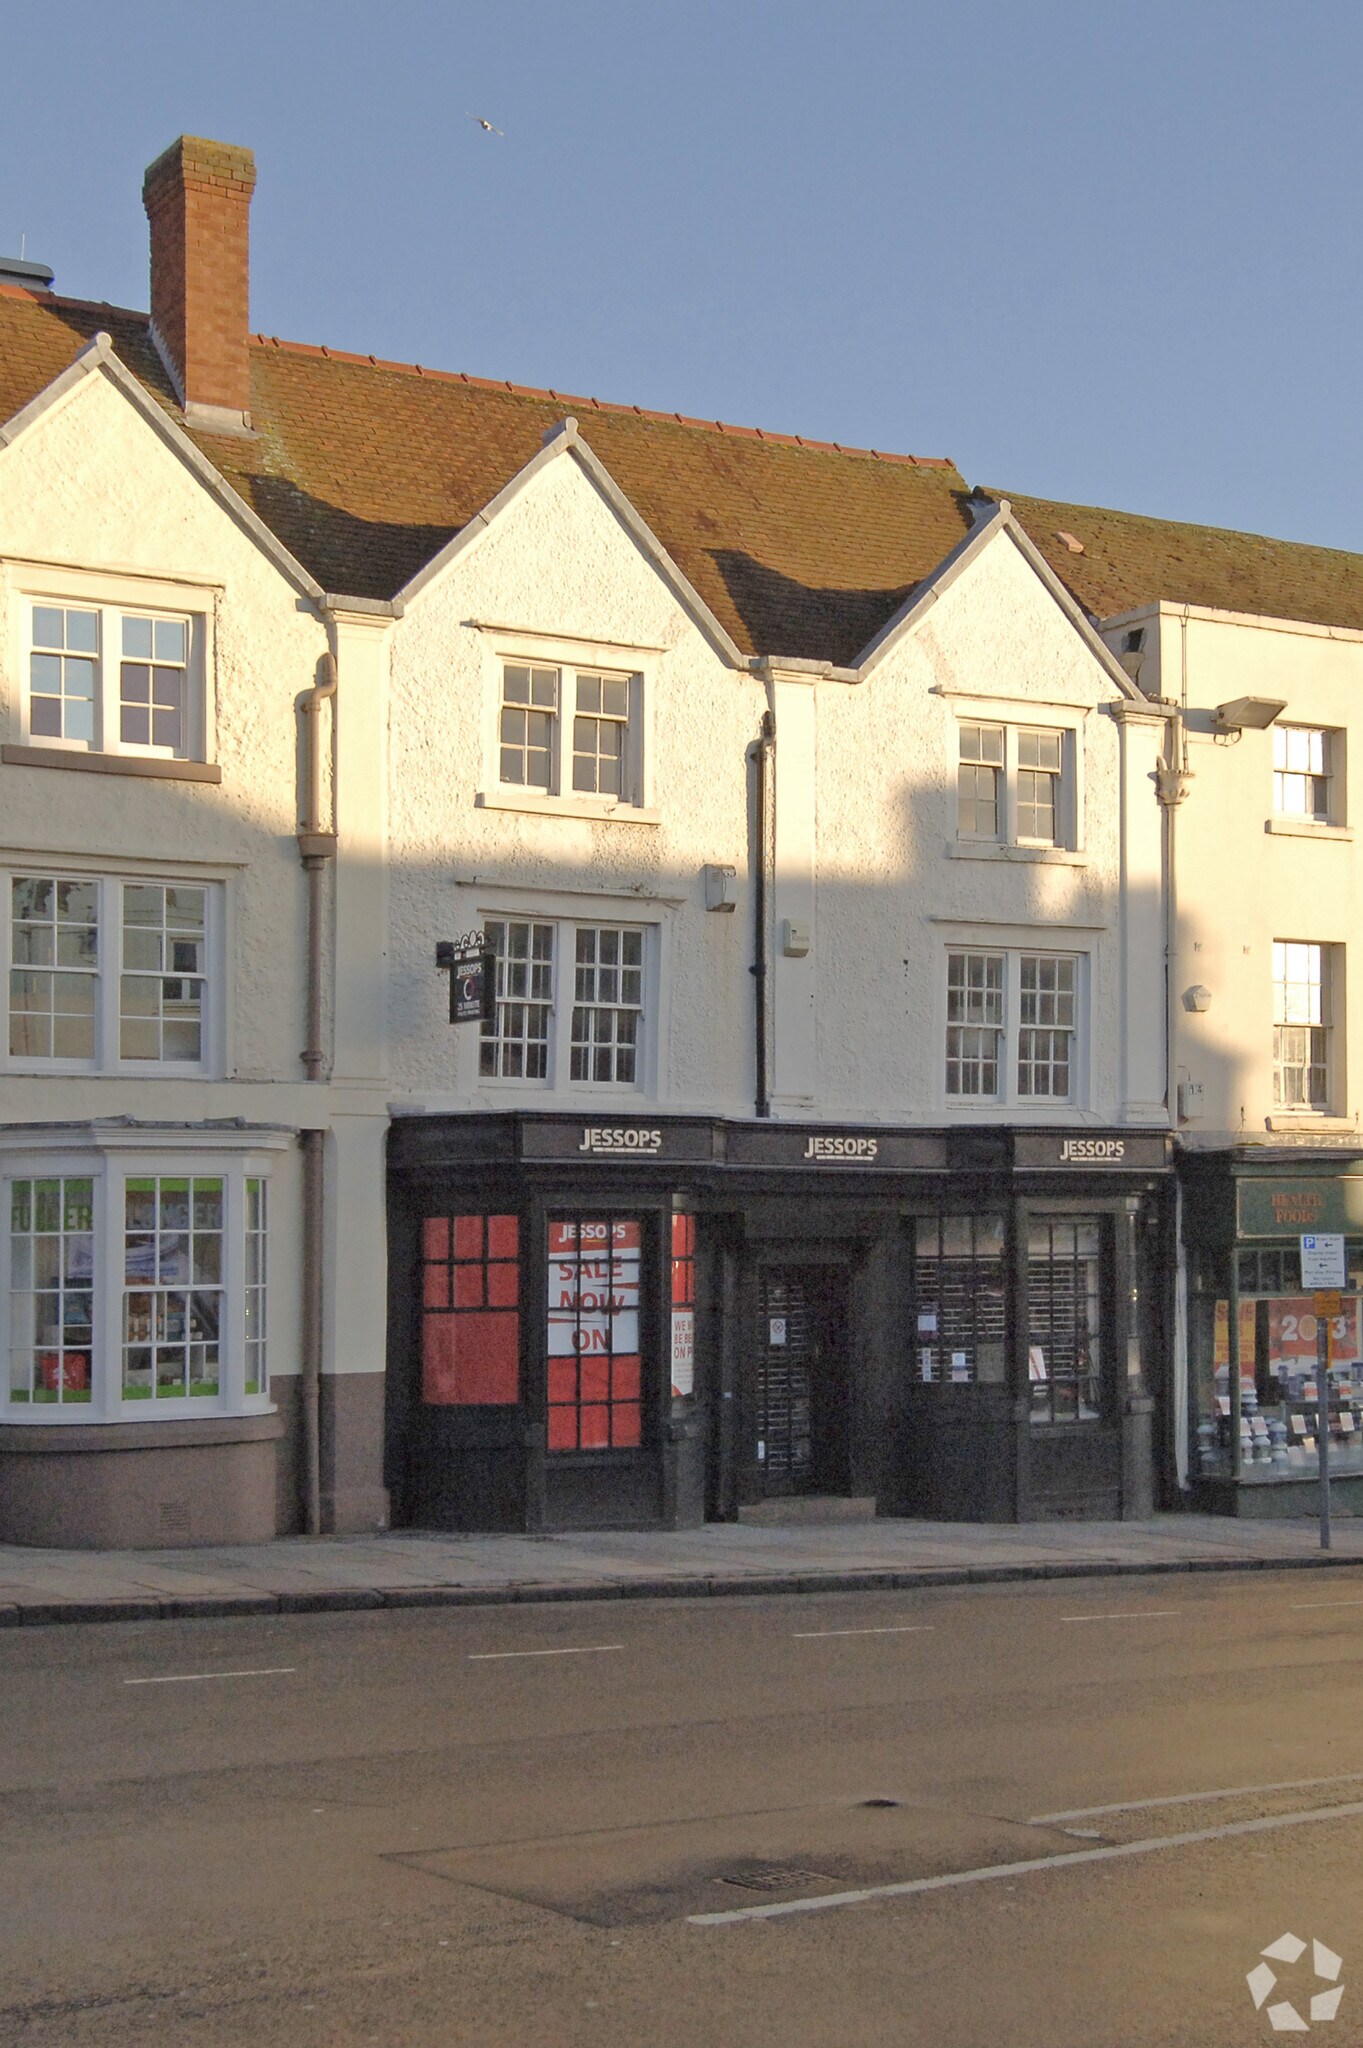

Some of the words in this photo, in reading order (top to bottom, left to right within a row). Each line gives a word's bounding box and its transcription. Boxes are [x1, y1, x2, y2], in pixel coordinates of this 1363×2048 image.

[579, 1129, 662, 1150] JESSOPS
[804, 1137, 877, 1158] JESSOPS
[1060, 1140, 1125, 1160] JESSOPS
[559, 1256, 623, 1281] SALE
[560, 1290, 625, 1316] NOW
[572, 1329, 610, 1352] ON
